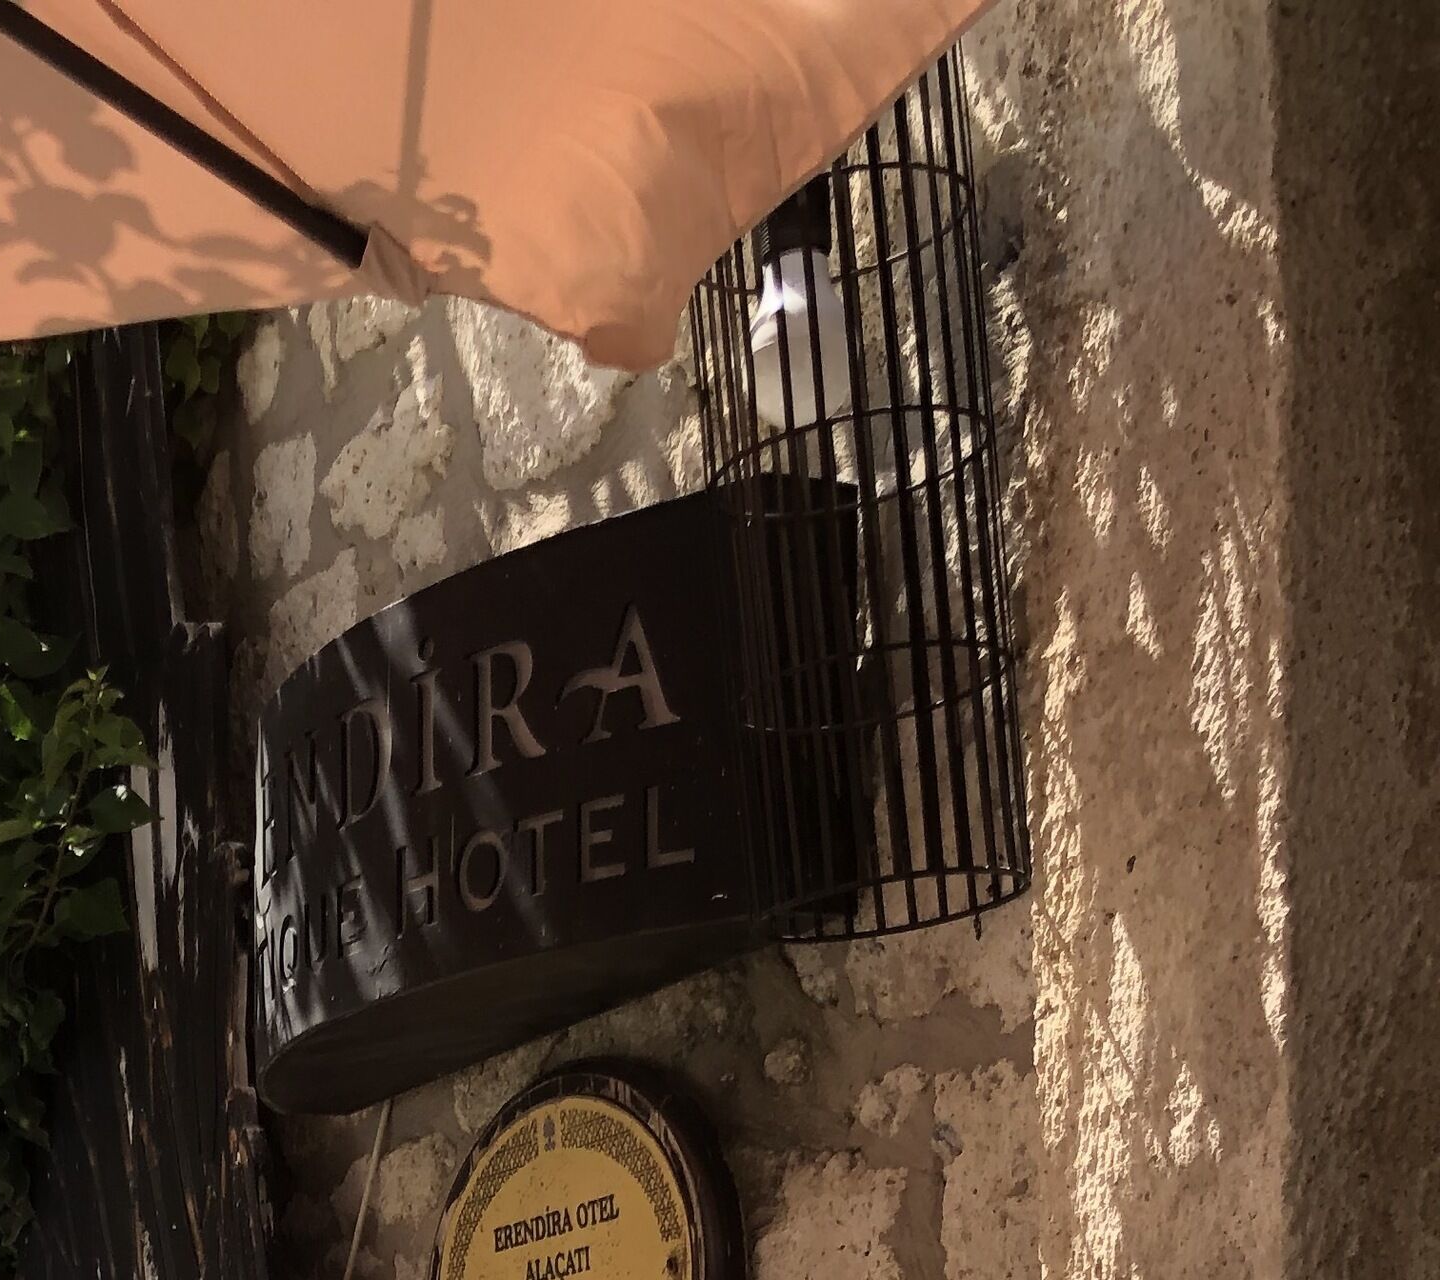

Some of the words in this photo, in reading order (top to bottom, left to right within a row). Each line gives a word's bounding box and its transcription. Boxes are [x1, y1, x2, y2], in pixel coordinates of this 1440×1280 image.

[395, 784, 696, 940] HOTEL
[493, 1205, 574, 1253] ERENDİRA
[576, 1193, 620, 1230] OTEL
